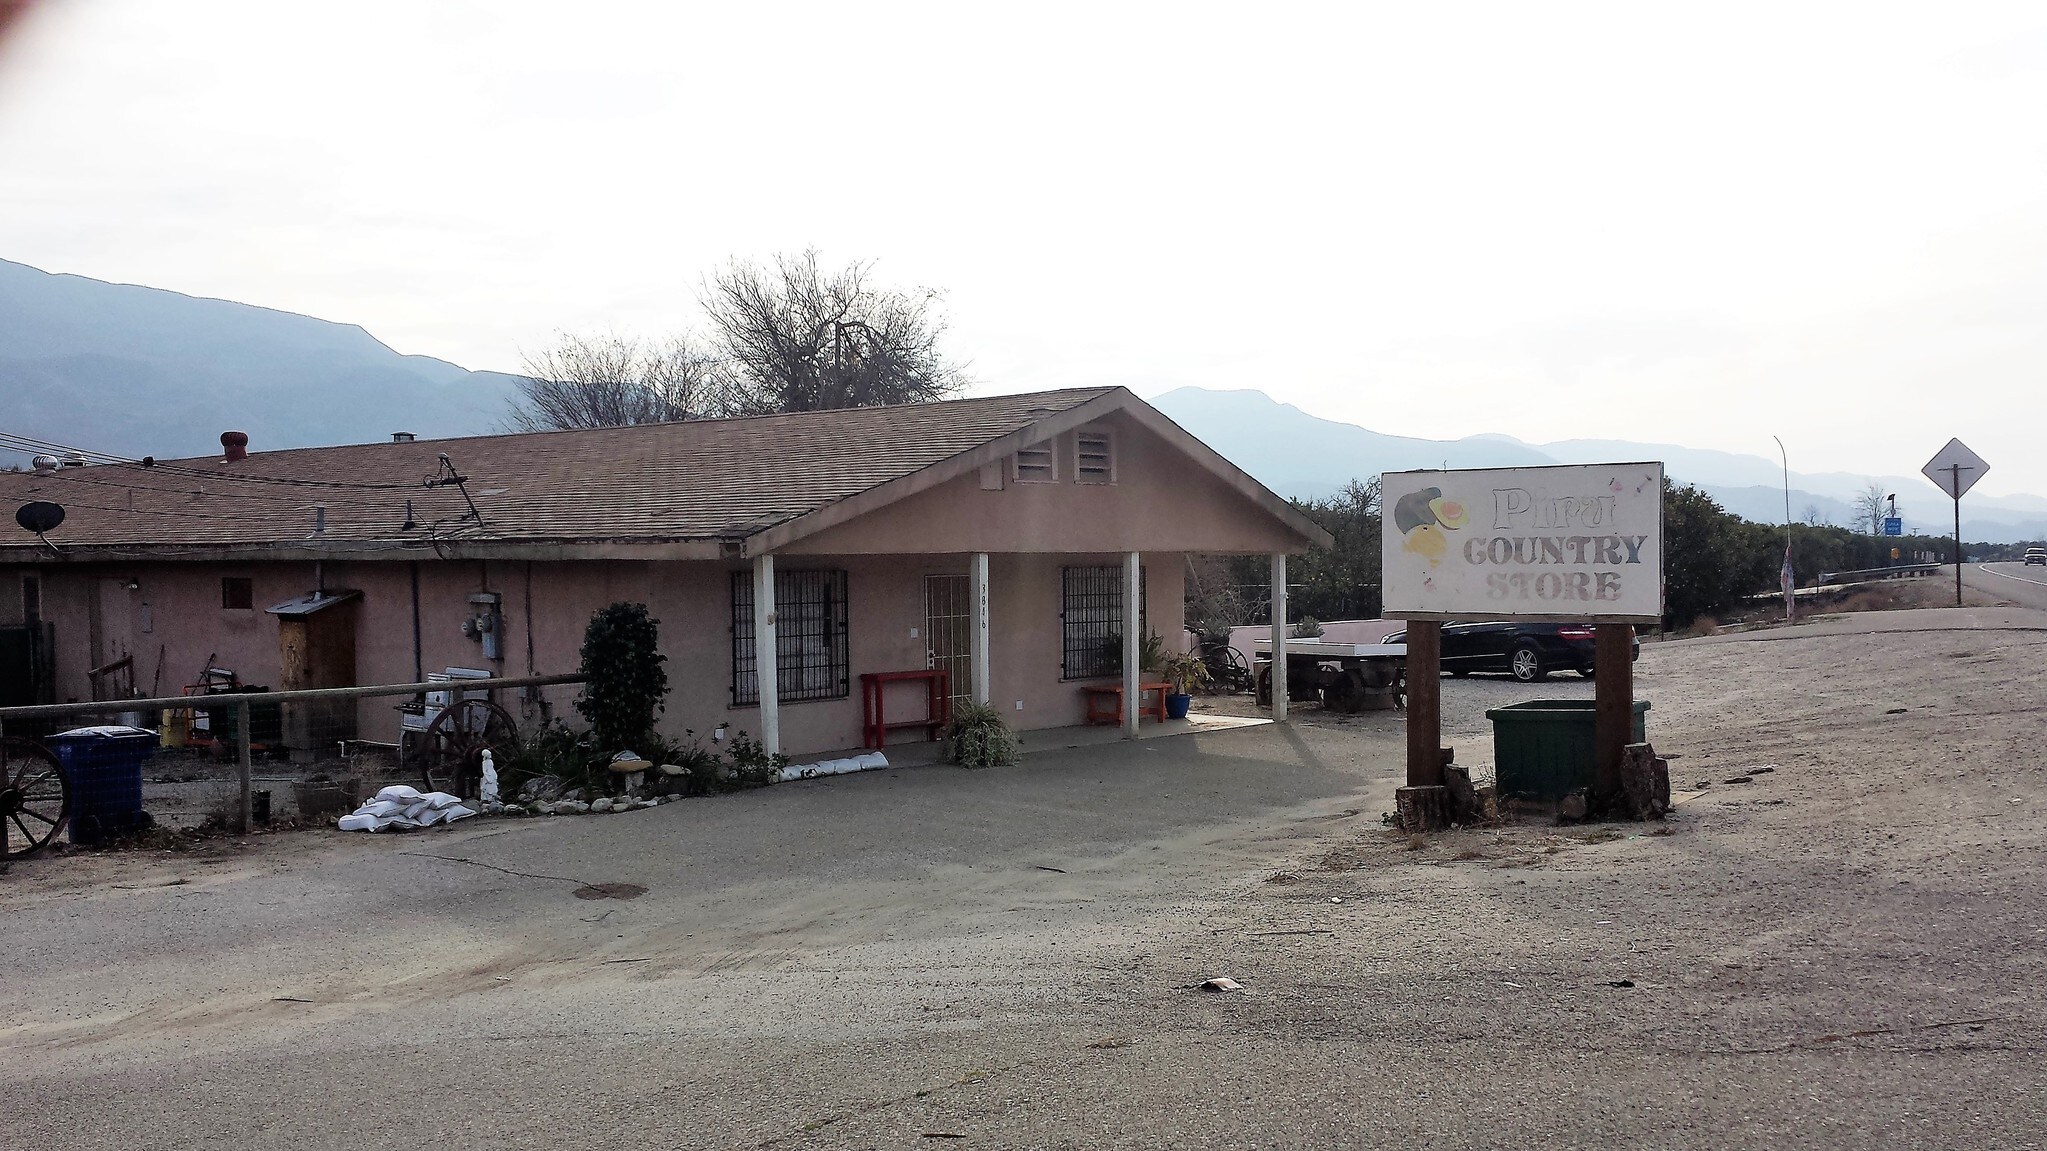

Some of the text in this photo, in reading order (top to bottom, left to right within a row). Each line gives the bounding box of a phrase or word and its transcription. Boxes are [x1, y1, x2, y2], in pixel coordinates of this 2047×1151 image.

[1492, 488, 1615, 529] Piru
[1463, 535, 1648, 565] COUNTRY
[1486, 572, 1622, 601] STORE
